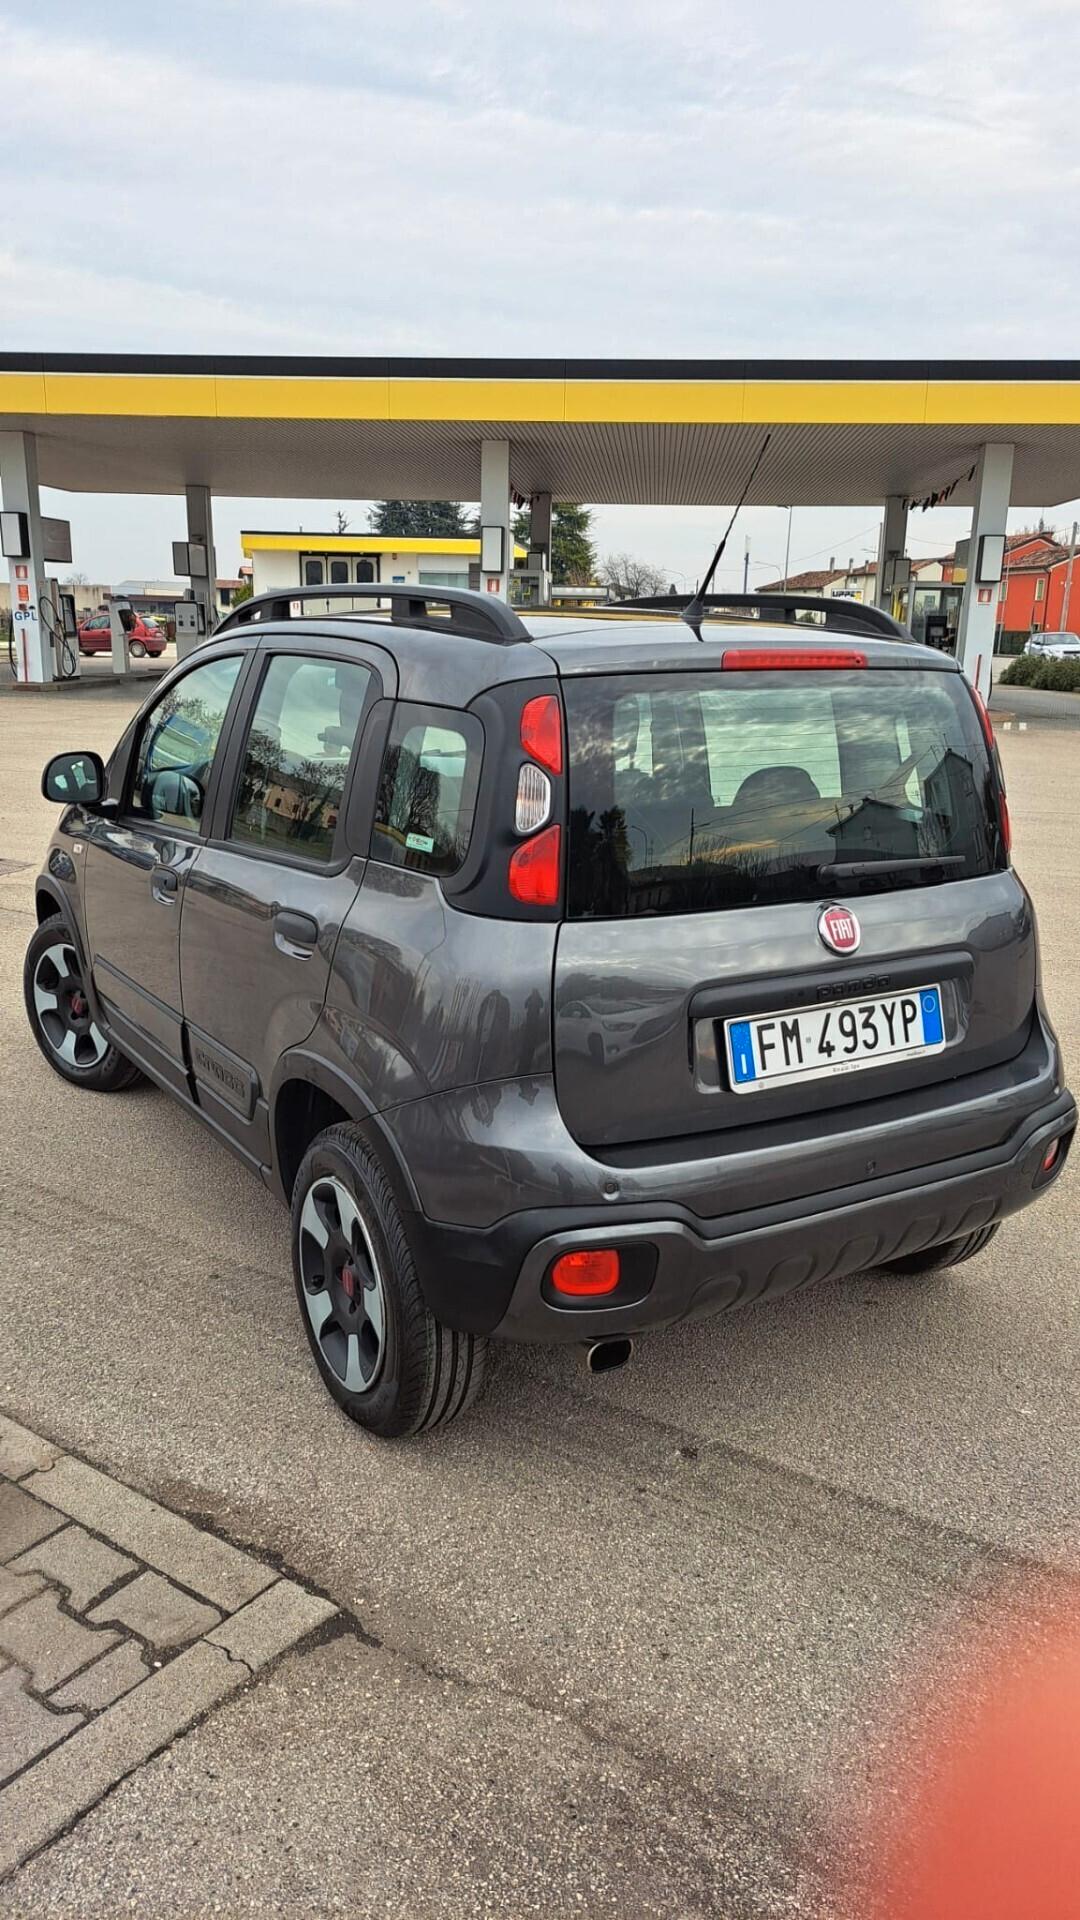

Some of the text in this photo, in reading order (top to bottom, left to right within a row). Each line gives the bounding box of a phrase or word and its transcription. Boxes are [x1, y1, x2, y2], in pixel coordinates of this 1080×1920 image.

[14, 611, 38, 621] GPL
[830, 918, 854, 940] FIAT
[816, 973, 890, 1000] panda
[756, 999, 918, 1071] FM 493YP
